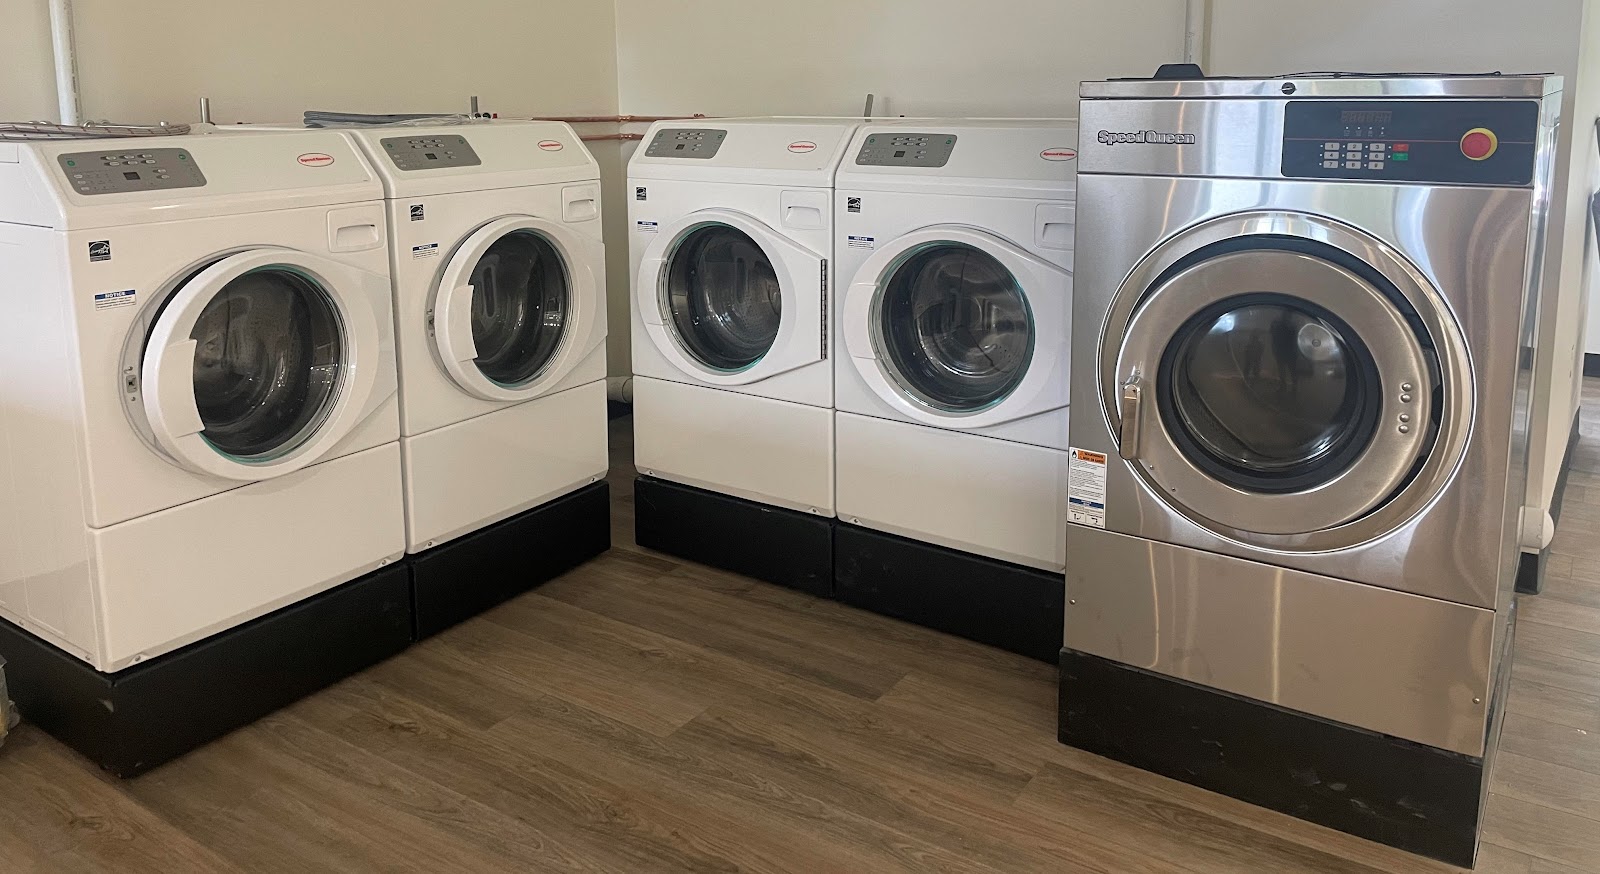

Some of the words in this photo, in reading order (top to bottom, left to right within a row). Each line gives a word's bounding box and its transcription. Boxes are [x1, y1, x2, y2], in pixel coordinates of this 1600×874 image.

[1098, 130, 1145, 145] Speed
[1145, 130, 1195, 144] Queen
[105, 291, 126, 299] NOTICE
